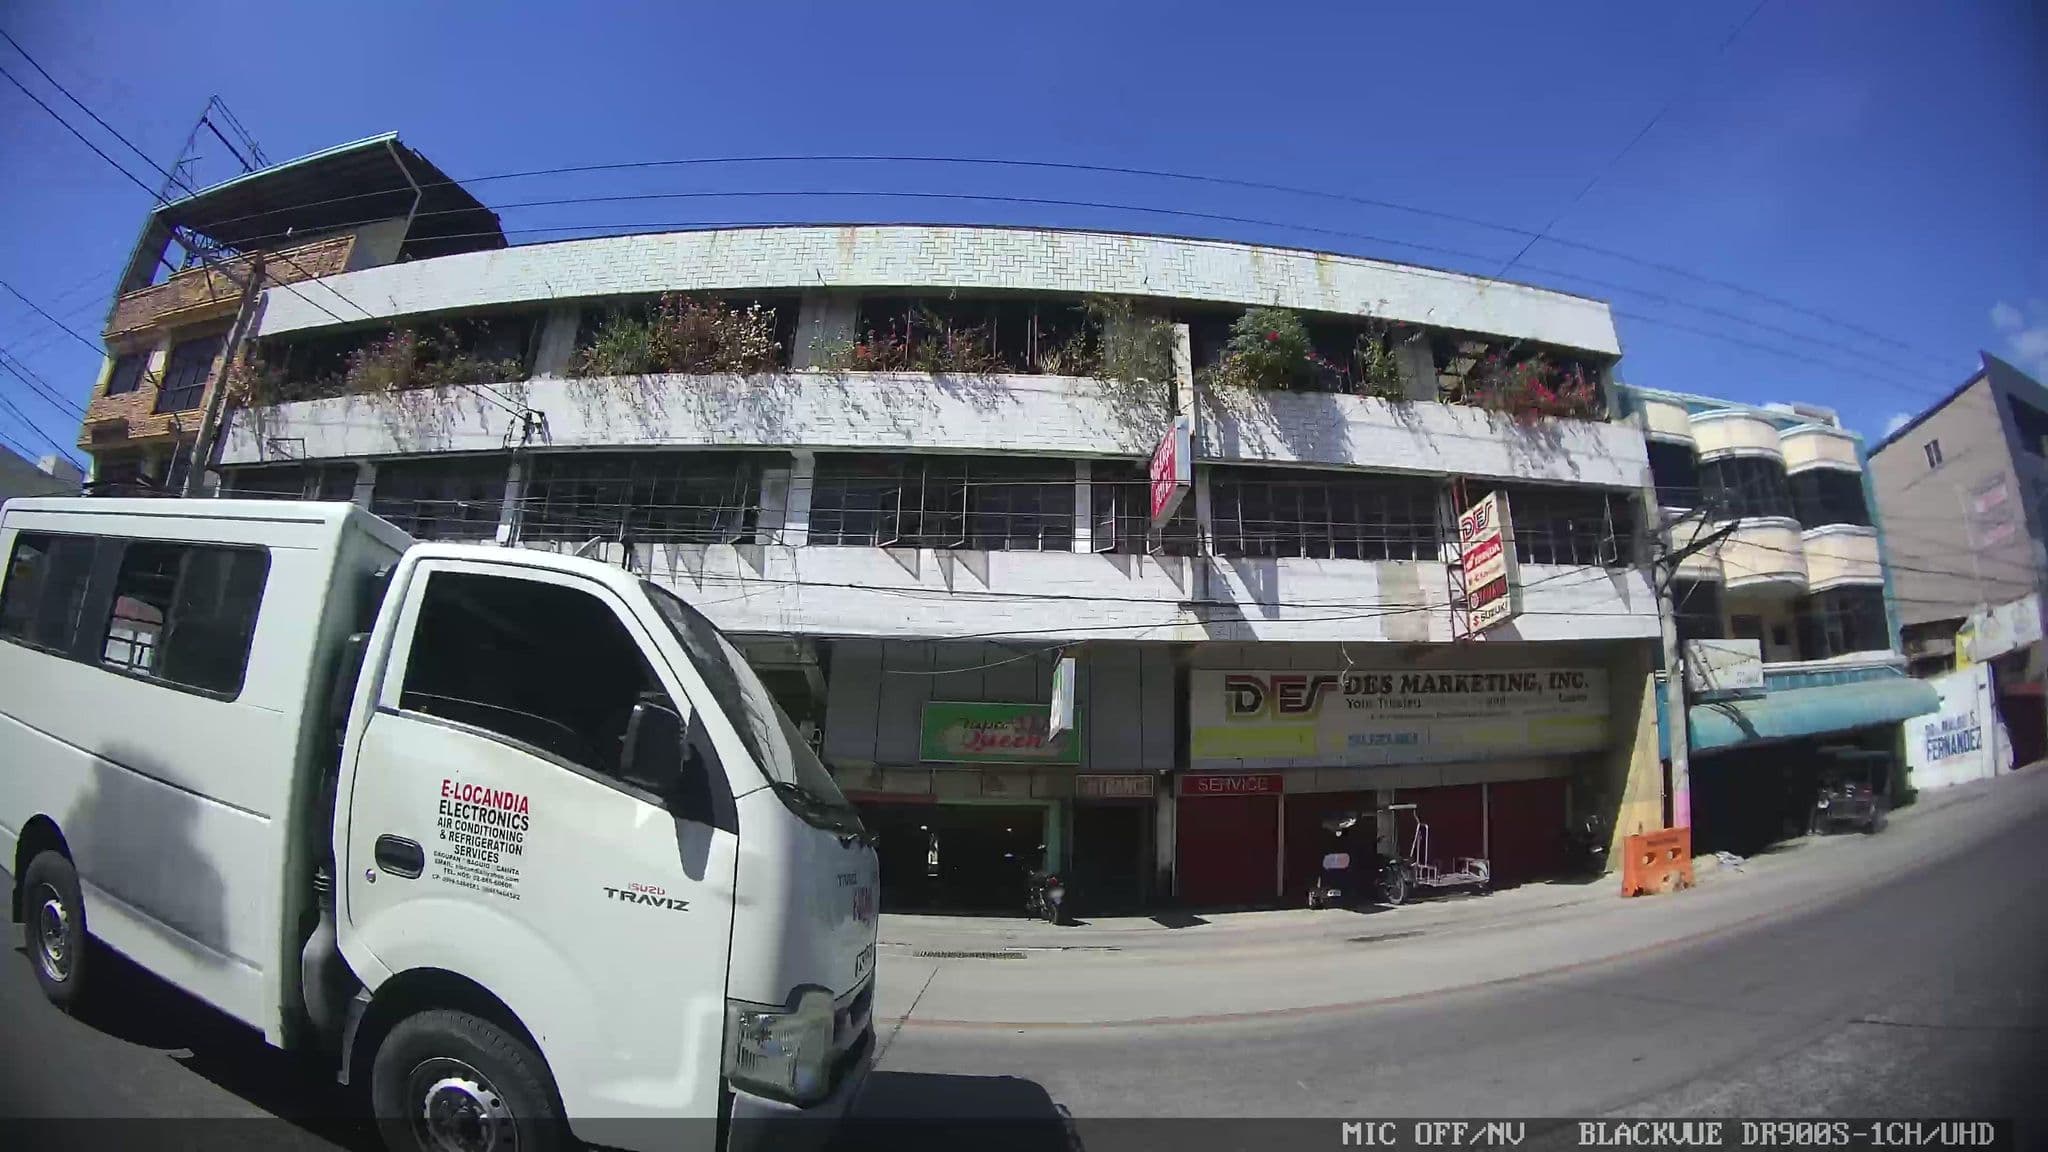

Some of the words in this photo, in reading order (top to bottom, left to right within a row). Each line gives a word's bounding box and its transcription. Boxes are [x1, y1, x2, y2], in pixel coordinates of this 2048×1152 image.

[1481, 602, 1508, 622] SUZUKI
[1343, 674, 1393, 696] DES
[1400, 672, 1541, 694] MARKETING,
[1549, 671, 1590, 691] INC.
[1225, 674, 1338, 719] DES
[1927, 727, 1982, 762] FERNANDEZ
[441, 779, 529, 814] E-LOCANDIA
[1198, 777, 1268, 792] SERVICE
[439, 799, 529, 831] ELECTRONICS
[437, 817, 453, 829] AIR
[454, 819, 523, 843] CONDITIONING
[439, 829, 447, 840] &
[448, 831, 523, 855] REFRIGERATION
[454, 844, 499, 863] SERVICES
[603, 887, 690, 912] TRAVIZ
[627, 883, 665, 896] ISUZU
